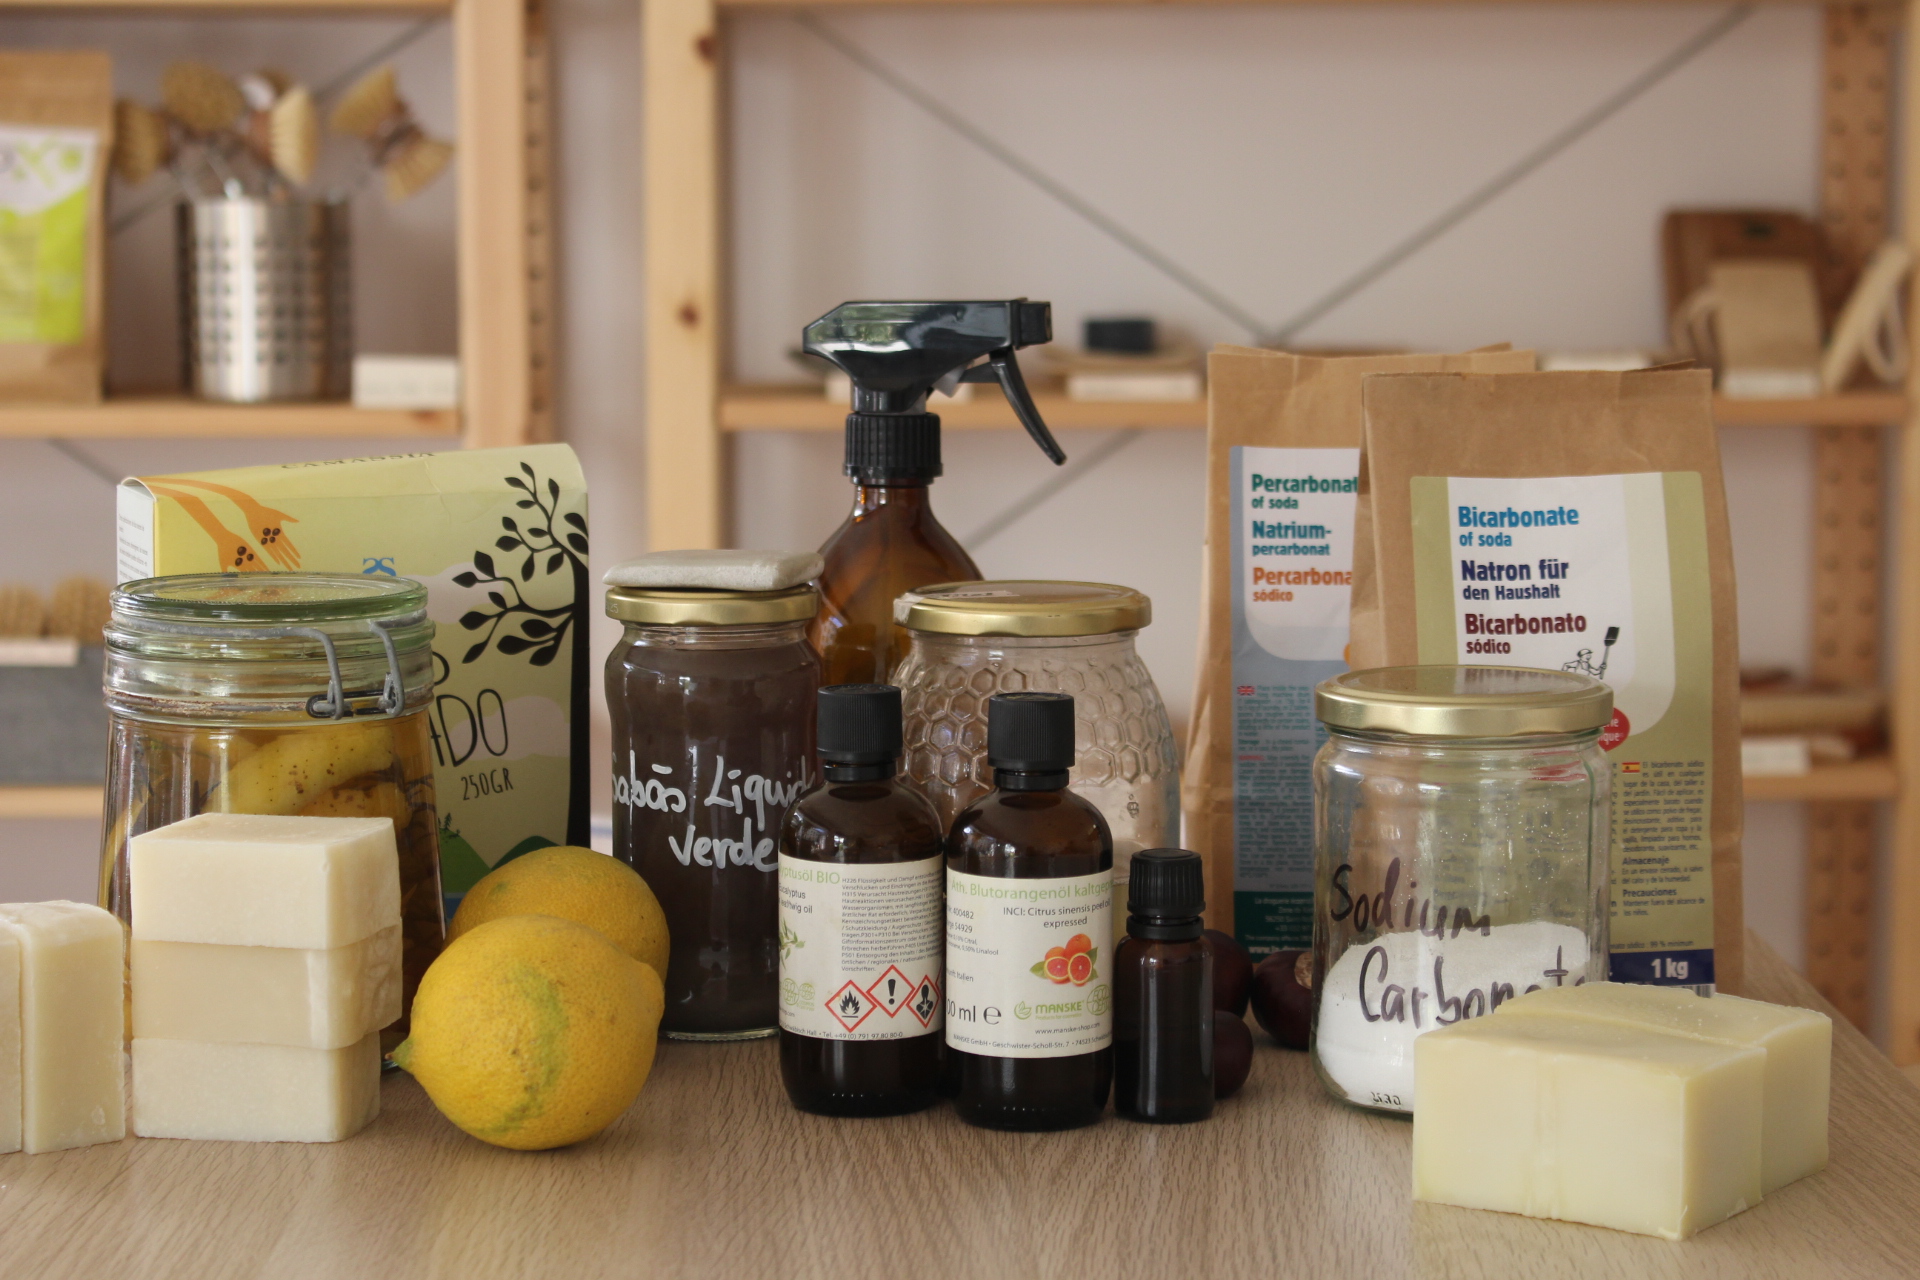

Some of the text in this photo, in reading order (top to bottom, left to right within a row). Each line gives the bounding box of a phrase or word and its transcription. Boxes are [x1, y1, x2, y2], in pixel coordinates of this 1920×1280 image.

[1251, 473, 1358, 494] Percarbonat
[1251, 496, 1299, 509] of soda
[1458, 506, 1579, 528] Bicarbonate
[1252, 520, 1332, 539] Natrium-
[1459, 532, 1512, 547] of soda
[1252, 543, 1331, 556] percarbonat
[1253, 567, 1352, 586] Percarbona
[1461, 559, 1569, 581] Natron für
[1253, 588, 1294, 602] sódico
[1463, 584, 1561, 600] den Haushalt
[1465, 613, 1587, 635] Bicarbonato
[1466, 639, 1511, 654] sódico
[460, 767, 514, 801] 250GR
[1622, 856, 1670, 866] Almacenaje
[816, 870, 840, 884] BIO
[970, 883, 1070, 903] Blutorangenöl
[1330, 857, 1491, 941] Sodium
[1622, 888, 1678, 897] Precauciones
[803, 905, 813, 914] oil
[1003, 907, 1026, 917] INCI:
[1027, 907, 1056, 917] Citrus
[1058, 904, 1090, 916] sinensis
[955, 921, 973, 934] 54929
[1043, 916, 1088, 930] expressed
[1651, 957, 1688, 980] 1 kg
[1359, 944, 1585, 1029] Carbont
[947, 998, 956, 1017] 00
[959, 1005, 976, 1023] ml
[1035, 1001, 1083, 1015] MANSKE
